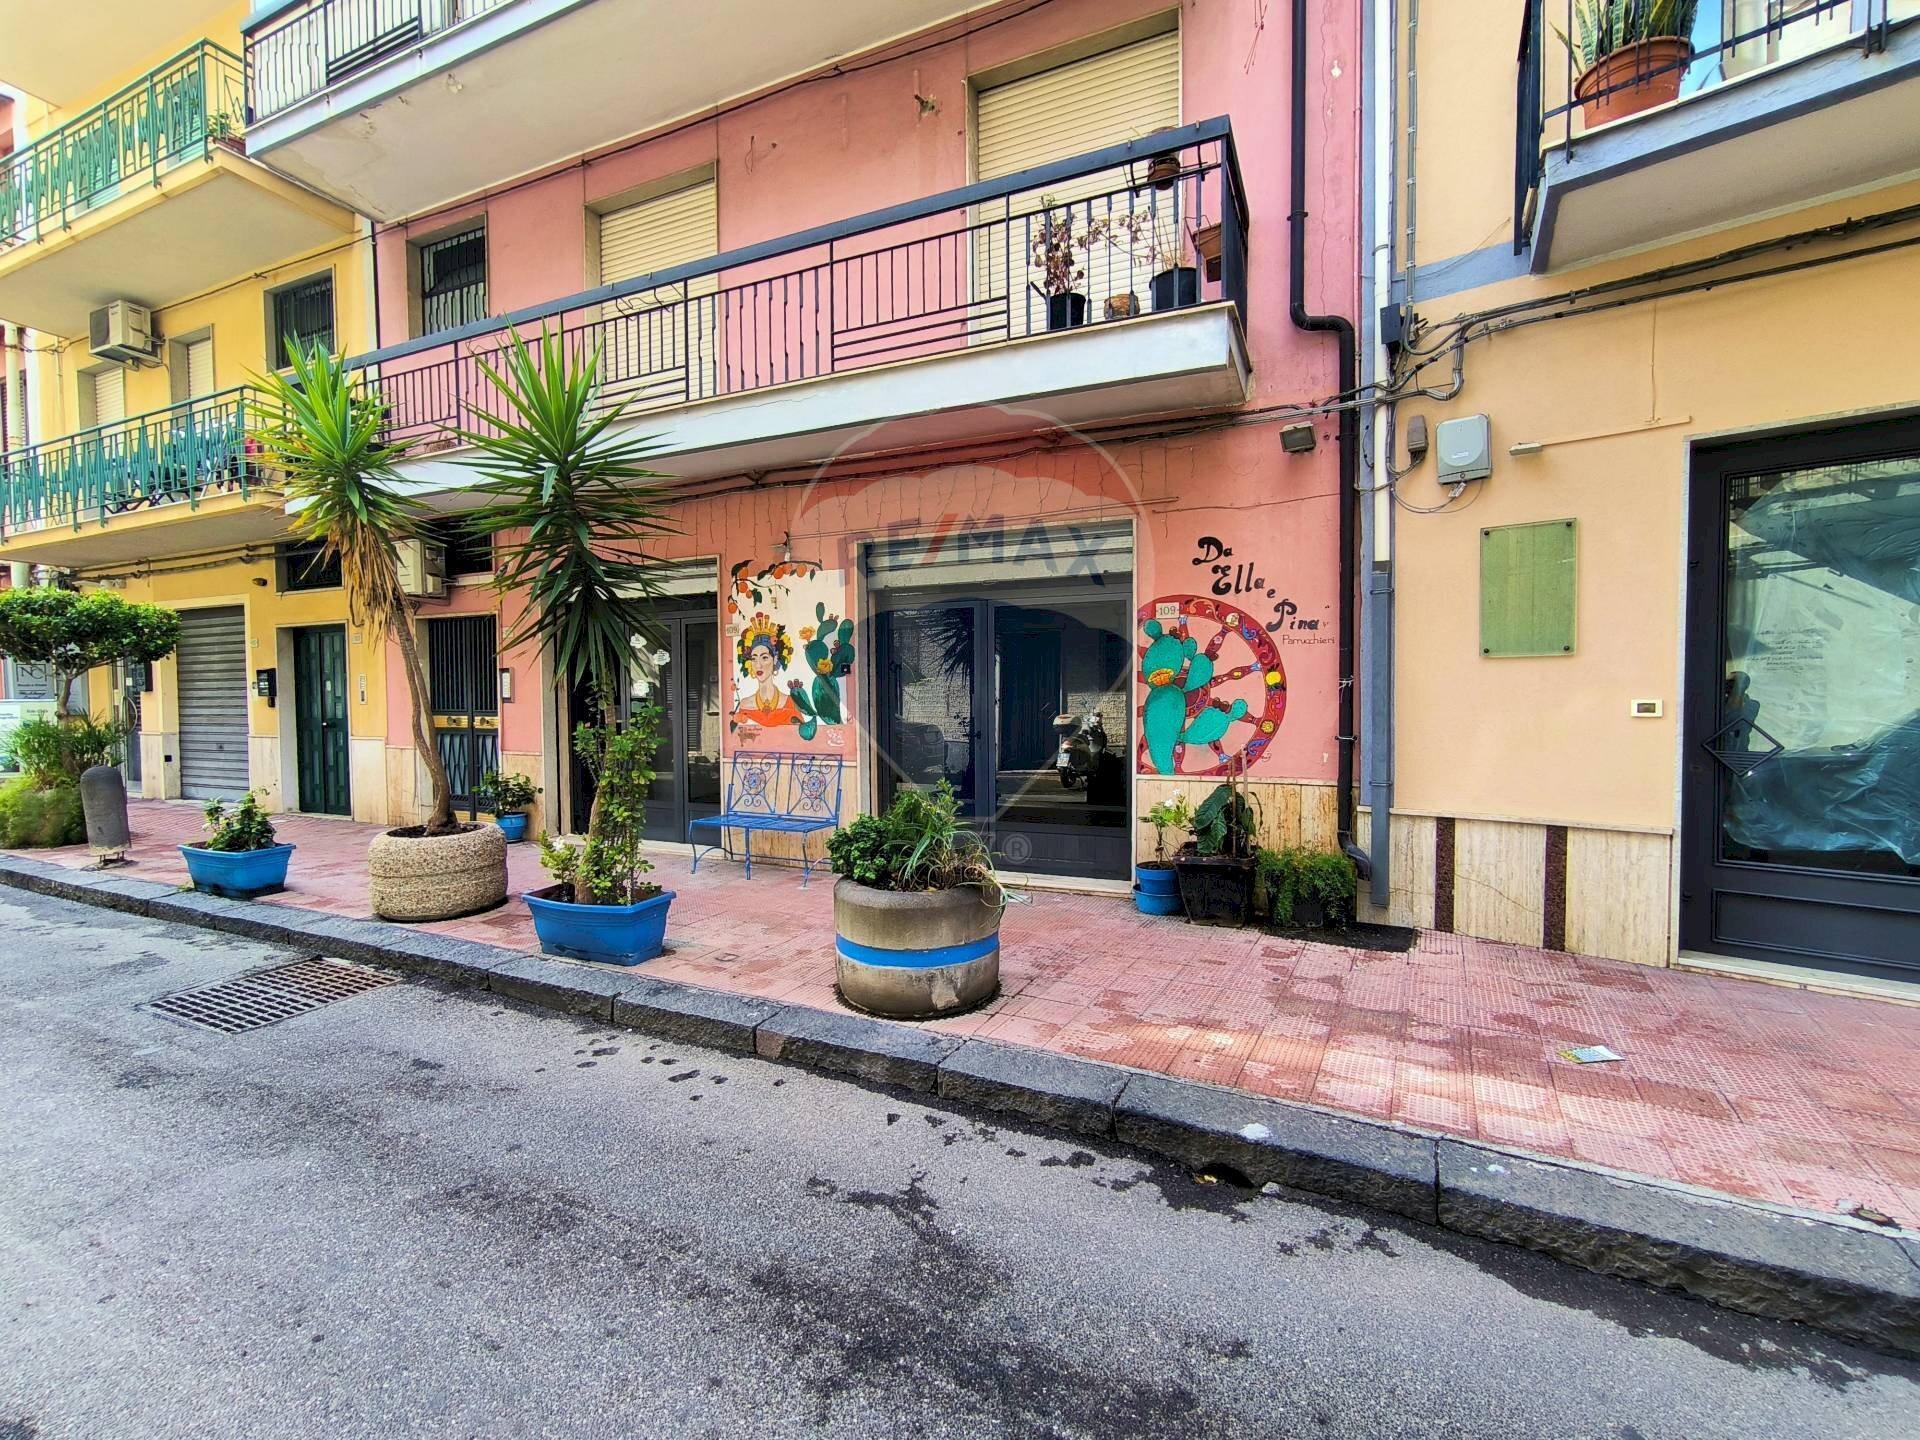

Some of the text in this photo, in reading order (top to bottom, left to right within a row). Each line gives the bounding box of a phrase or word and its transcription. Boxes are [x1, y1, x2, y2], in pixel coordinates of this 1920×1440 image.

[1192, 536, 1233, 566] Da
[1211, 562, 1276, 599] Ella e
[1159, 605, 1176, 616] 109
[1265, 598, 1320, 632] Pina
[1282, 634, 1335, 646] Parrucchieri
